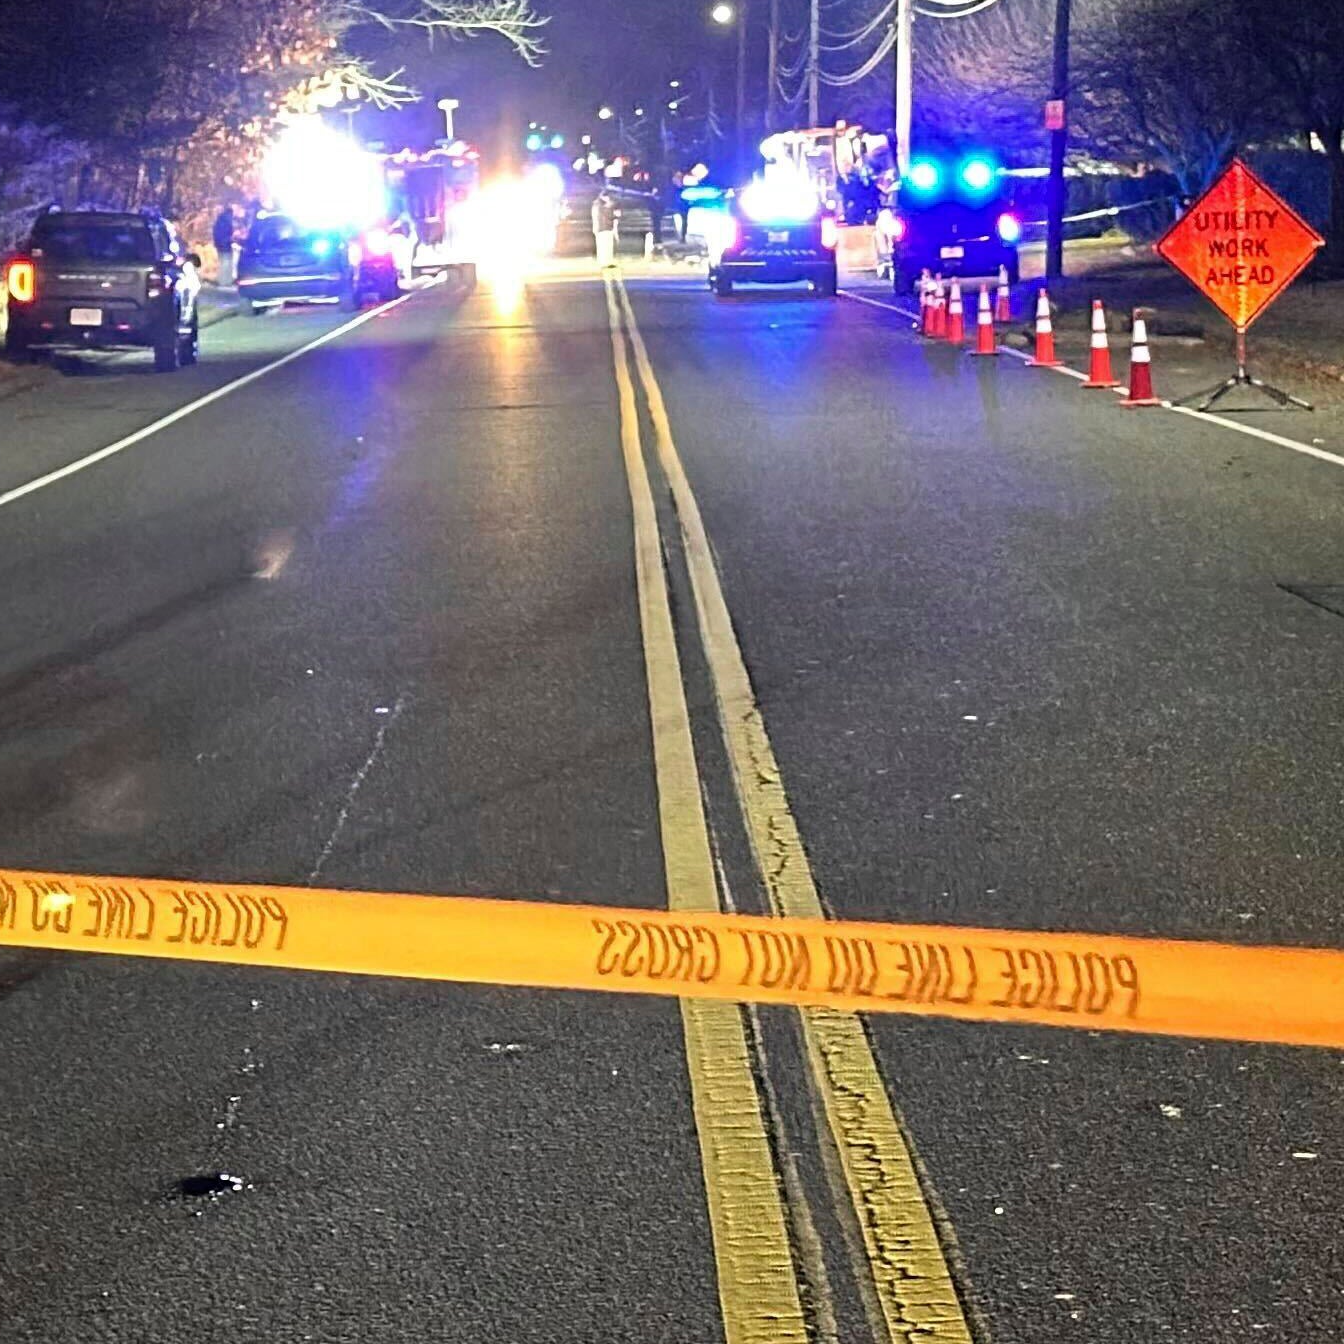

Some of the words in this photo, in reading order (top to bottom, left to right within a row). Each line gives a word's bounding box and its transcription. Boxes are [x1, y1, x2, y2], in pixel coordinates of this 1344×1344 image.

[1194, 209, 1279, 232] UTILITY
[1208, 238, 1270, 258] WORK
[1206, 264, 1275, 286] AHEAD
